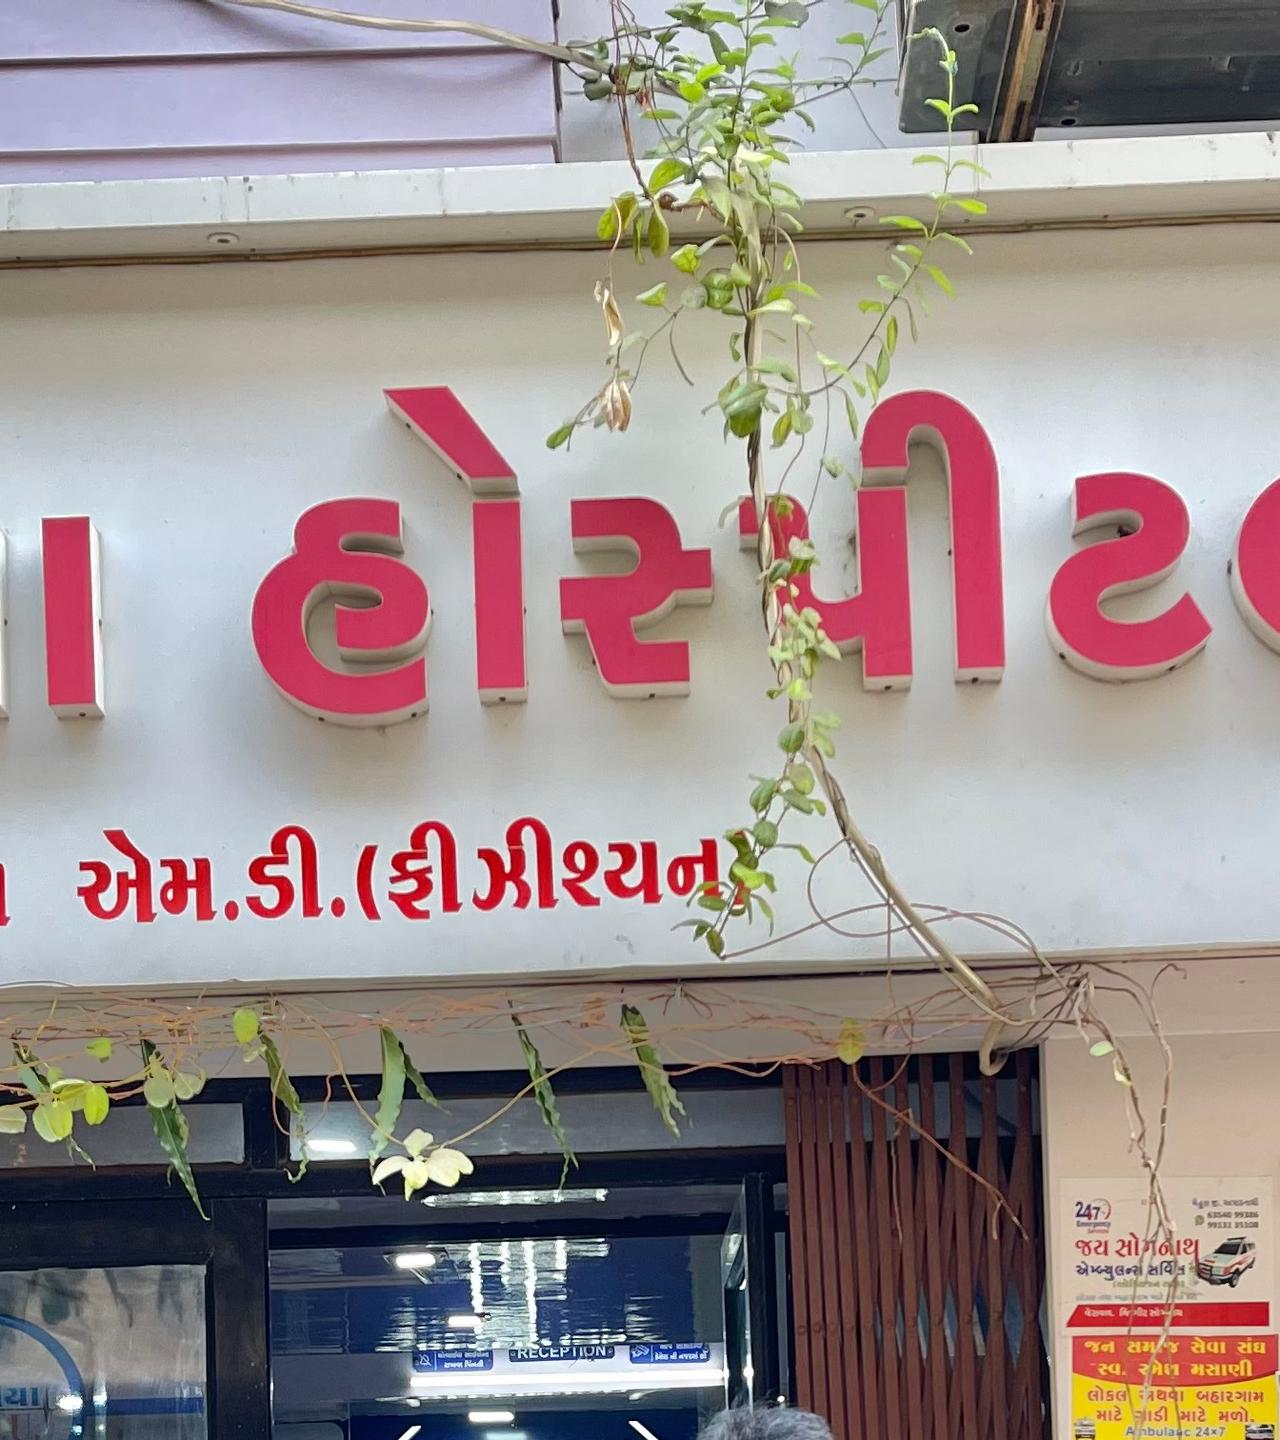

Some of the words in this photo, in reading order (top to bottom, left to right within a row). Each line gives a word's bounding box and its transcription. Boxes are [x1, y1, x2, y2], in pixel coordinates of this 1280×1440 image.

[1075, 1238, 1109, 1258] જય
[517, 1345, 607, 1360] RECEPTION
[1084, 1340, 1116, 1354] જન
[1190, 1336, 1227, 1355] સેવા
[1190, 1358, 1253, 1378] મસાણી
[1087, 1385, 1128, 1403] લોકલ
[1196, 1388, 1265, 1403] બહારગામ
[1096, 1405, 1122, 1422] માટે
[1178, 1405, 1207, 1422] માટે
[1218, 1405, 1256, 1423] મળો.
